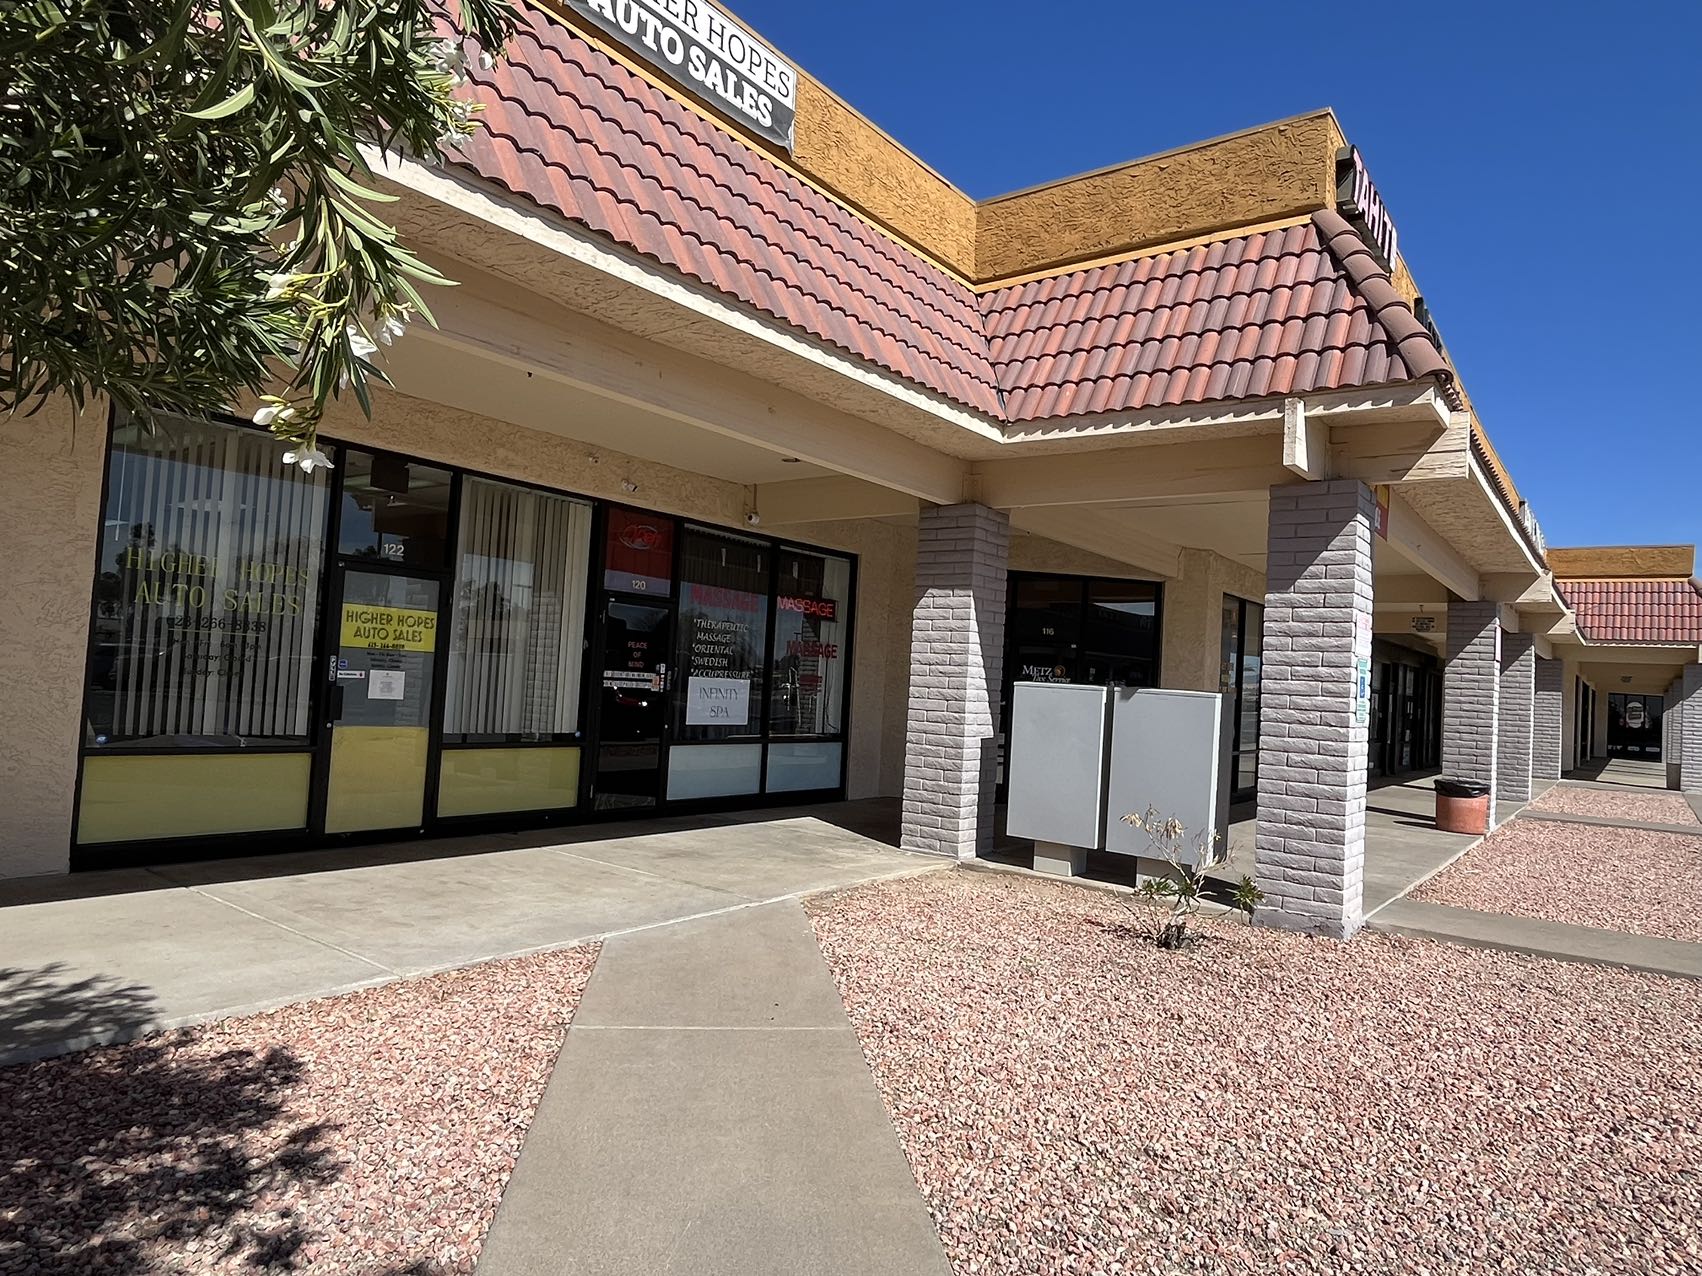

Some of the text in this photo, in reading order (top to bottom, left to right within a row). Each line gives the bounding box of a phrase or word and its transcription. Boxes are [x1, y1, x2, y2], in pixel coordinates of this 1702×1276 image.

[653, 0, 790, 98] ER HOPES
[585, 0, 773, 127] AUTO SALES
[384, 543, 404, 556] 122
[632, 580, 646, 590] 120
[135, 580, 301, 616] AUTO SALES
[777, 595, 834, 617] MASSAGE
[346, 610, 435, 629] HIGHER HOPES
[353, 626, 422, 642] AUTO SALES
[696, 632, 731, 643] MASSAGE
[1042, 627, 1055, 636] 116
[694, 643, 734, 655] ORIENTAL
[692, 656, 728, 667] SWEDISH
[1022, 664, 1052, 675] METZ
[699, 687, 739, 701] INFINITY
[708, 705, 730, 718] SPA
